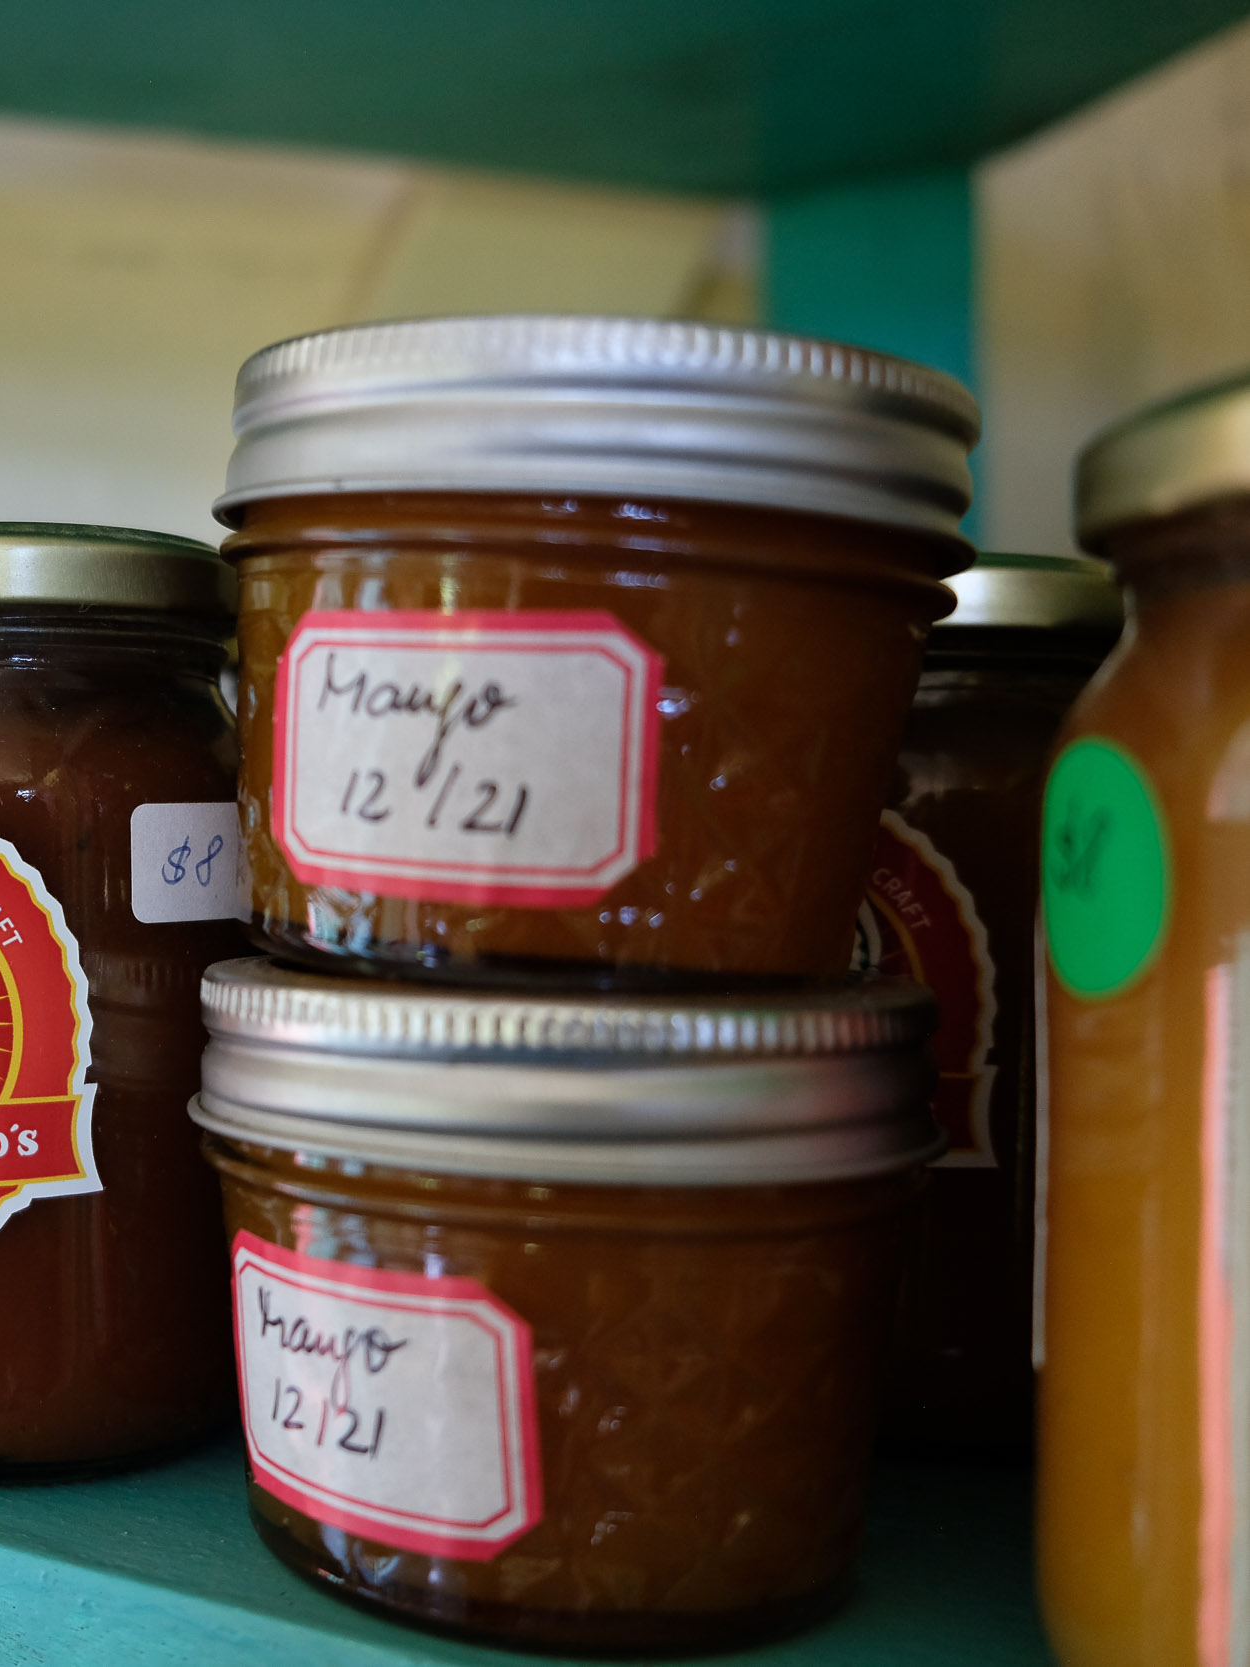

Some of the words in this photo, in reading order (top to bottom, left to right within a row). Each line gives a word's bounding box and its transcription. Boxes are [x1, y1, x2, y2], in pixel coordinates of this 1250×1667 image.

[317, 651, 517, 788] Mango
[161, 834, 224, 886] $8
[872, 867, 931, 929] CRAFT
[271, 1378, 387, 1460] 12/21
